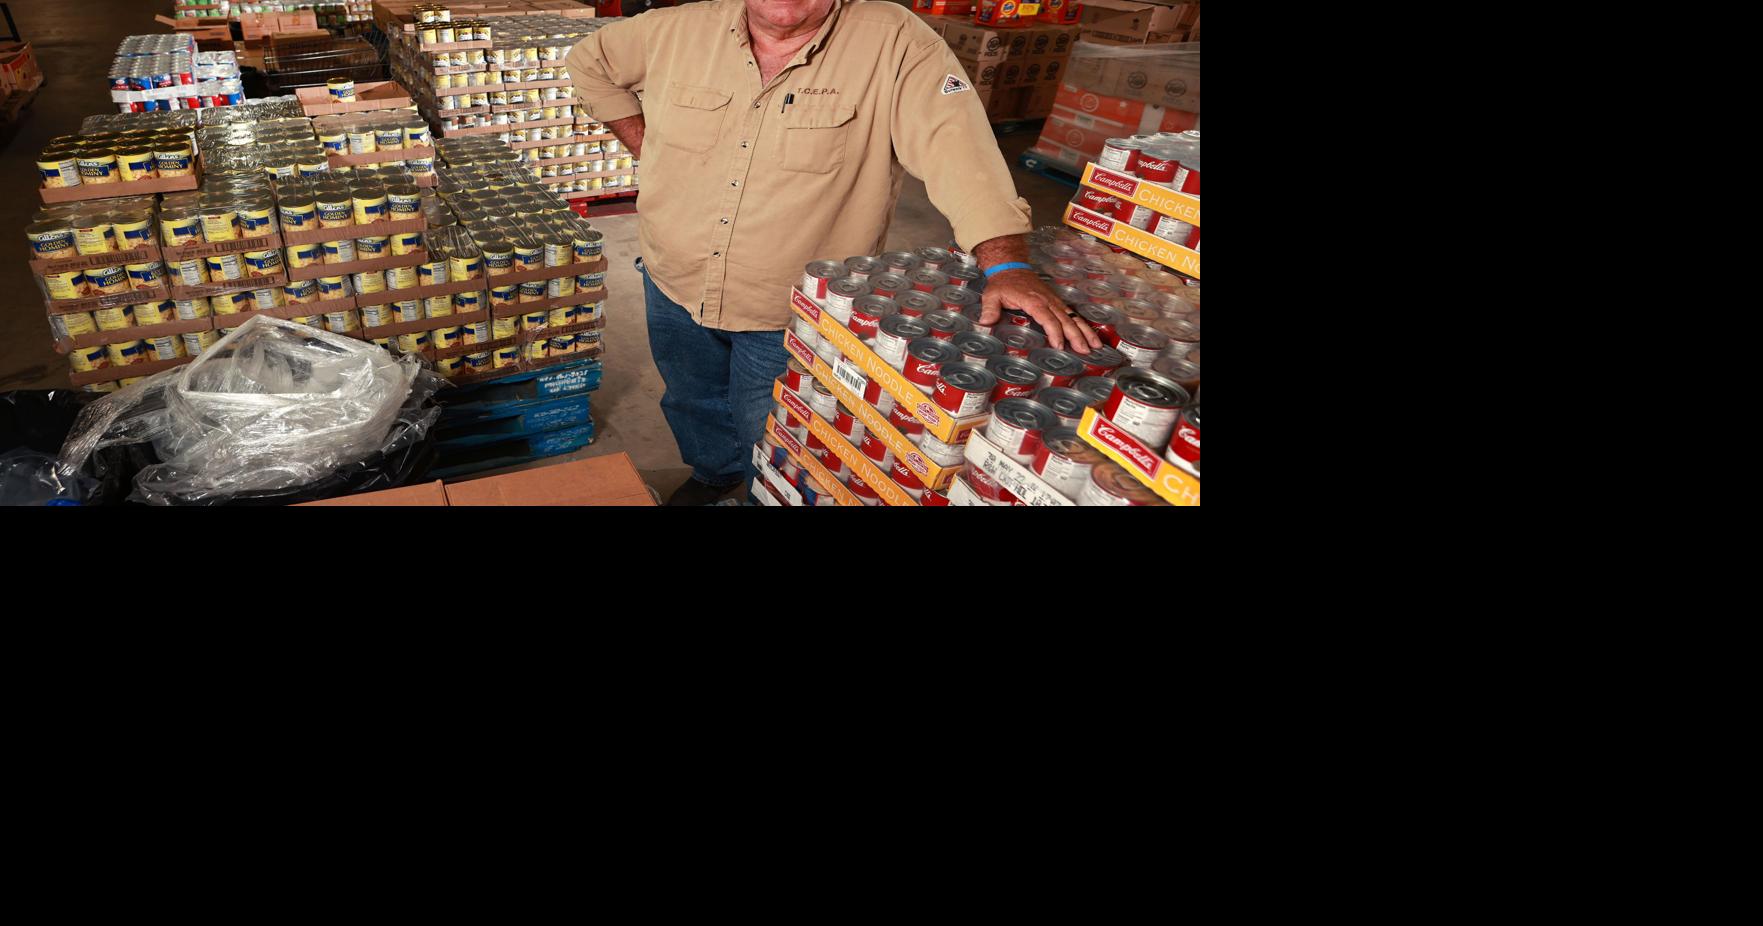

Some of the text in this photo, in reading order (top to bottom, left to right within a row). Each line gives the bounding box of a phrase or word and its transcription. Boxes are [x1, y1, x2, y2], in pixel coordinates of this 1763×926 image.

[1115, 229, 1177, 262] CHICKEN
[821, 319, 864, 362] CHICKEN
[867, 357, 914, 404] NOODLE
[813, 420, 857, 465] CHICKEN
[859, 404, 904, 453] NOODLE
